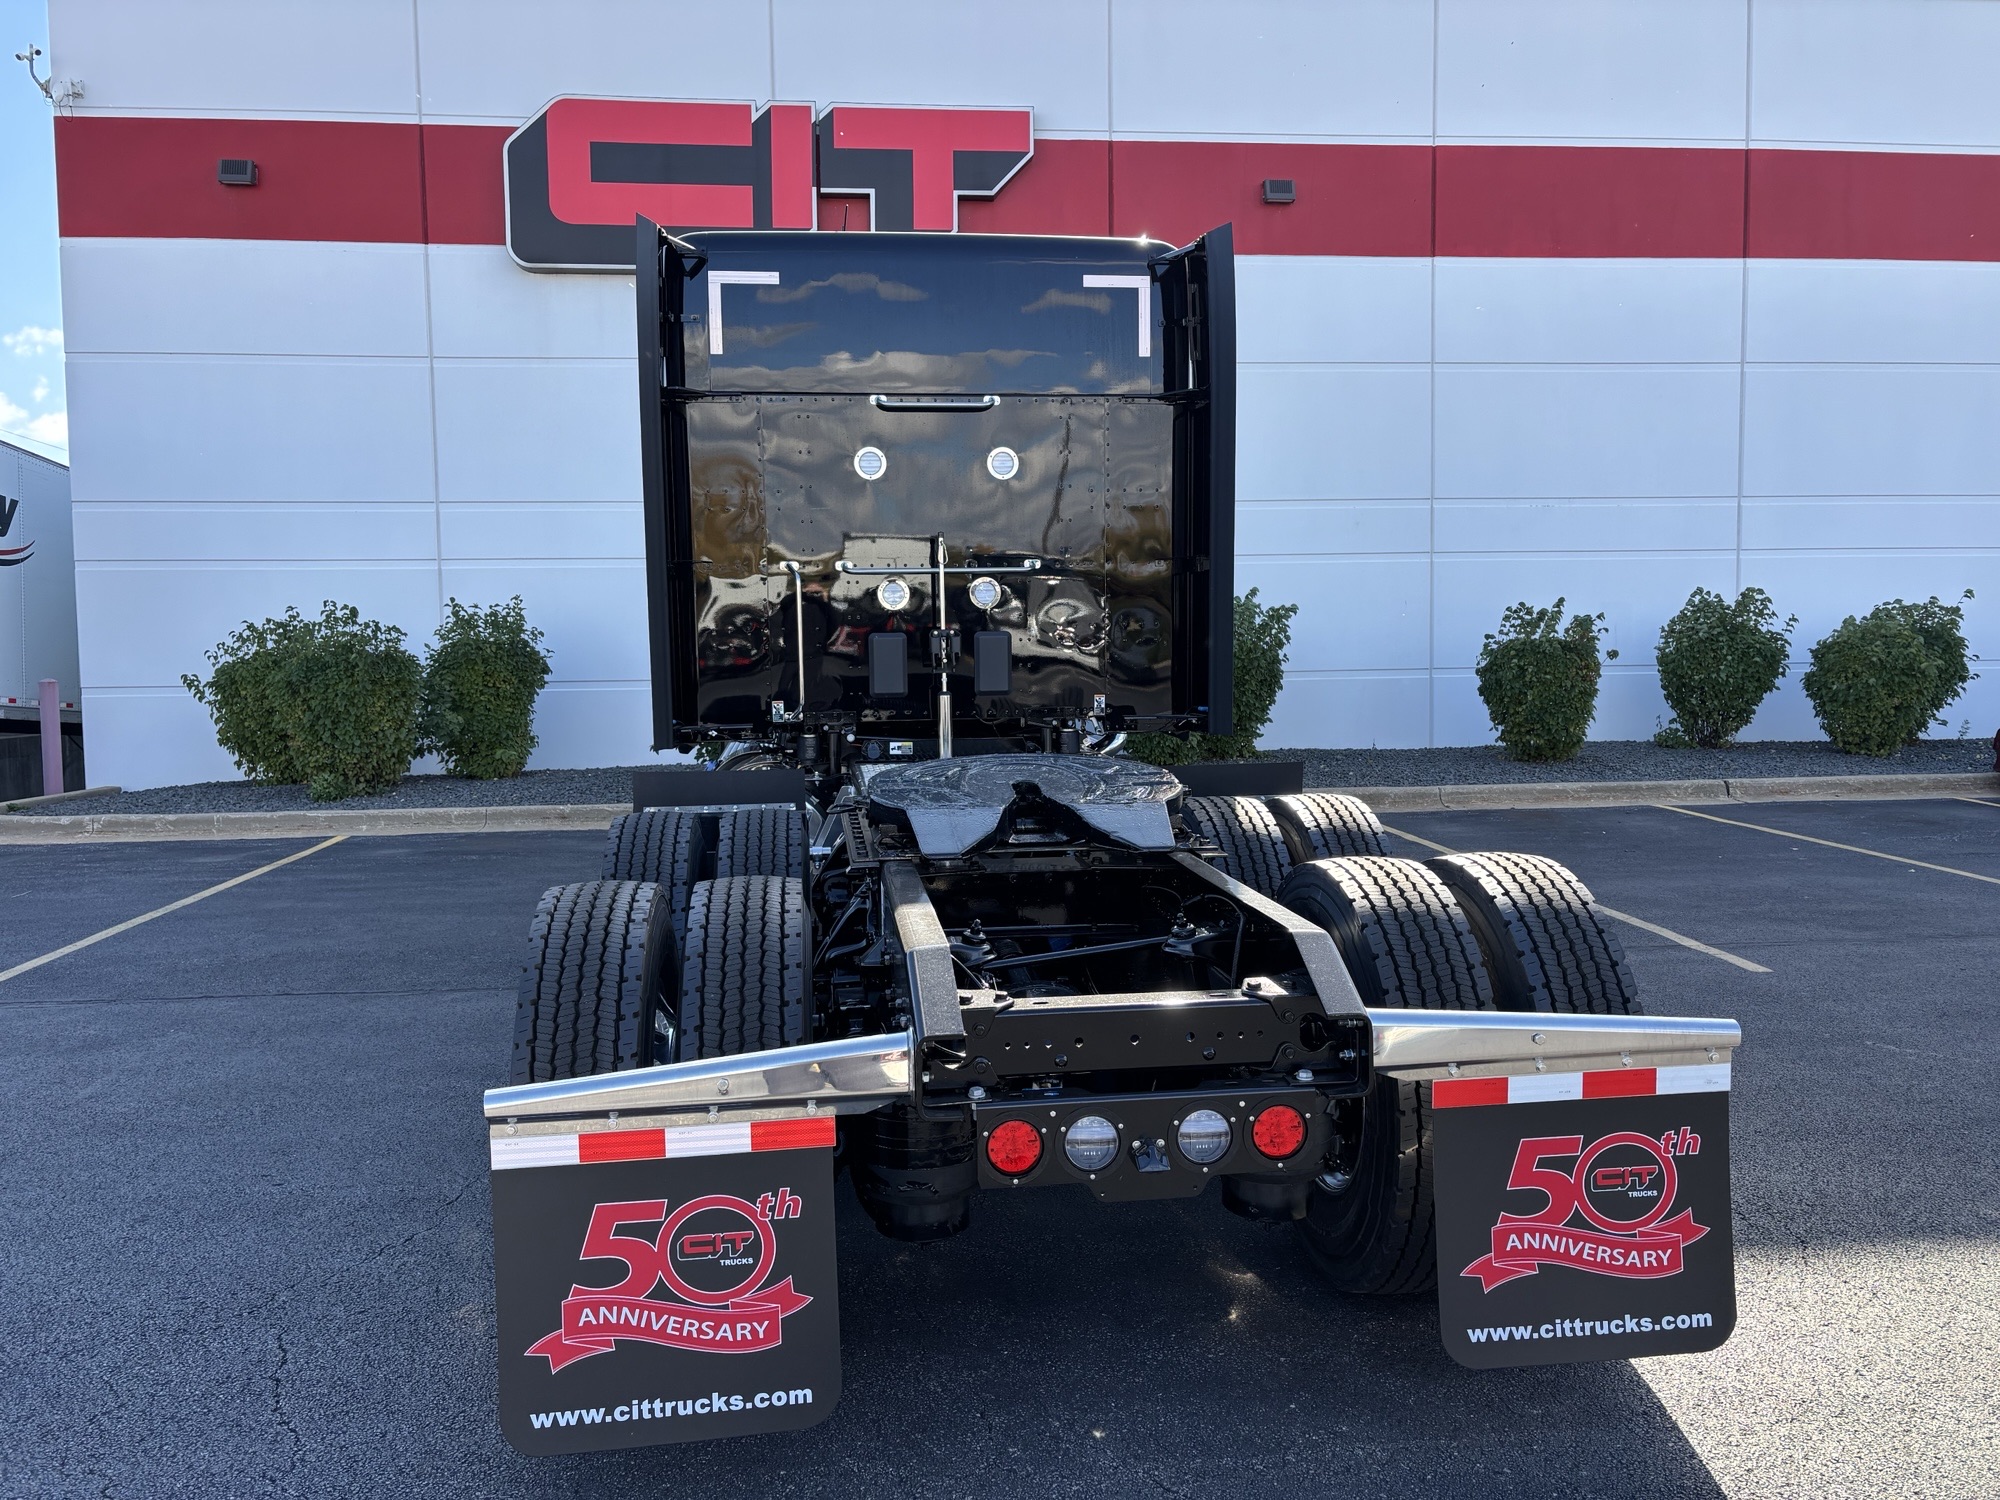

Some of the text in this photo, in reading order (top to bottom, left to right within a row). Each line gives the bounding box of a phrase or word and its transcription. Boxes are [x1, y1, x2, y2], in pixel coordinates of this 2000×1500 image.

[546, 97, 1031, 232] CIT
[1594, 1166, 1658, 1189] CIT
[1627, 1189, 1658, 1198] TRUCKS
[680, 1231, 754, 1258] CIT
[1505, 1233, 1673, 1268] ANNIVERSARY
[719, 1257, 754, 1267] TRUCKS
[578, 1306, 770, 1341] ANNIVERSARY
[1467, 1311, 1713, 1343] www.cittrucks.com
[530, 1386, 813, 1429] www.cittrucks.com
